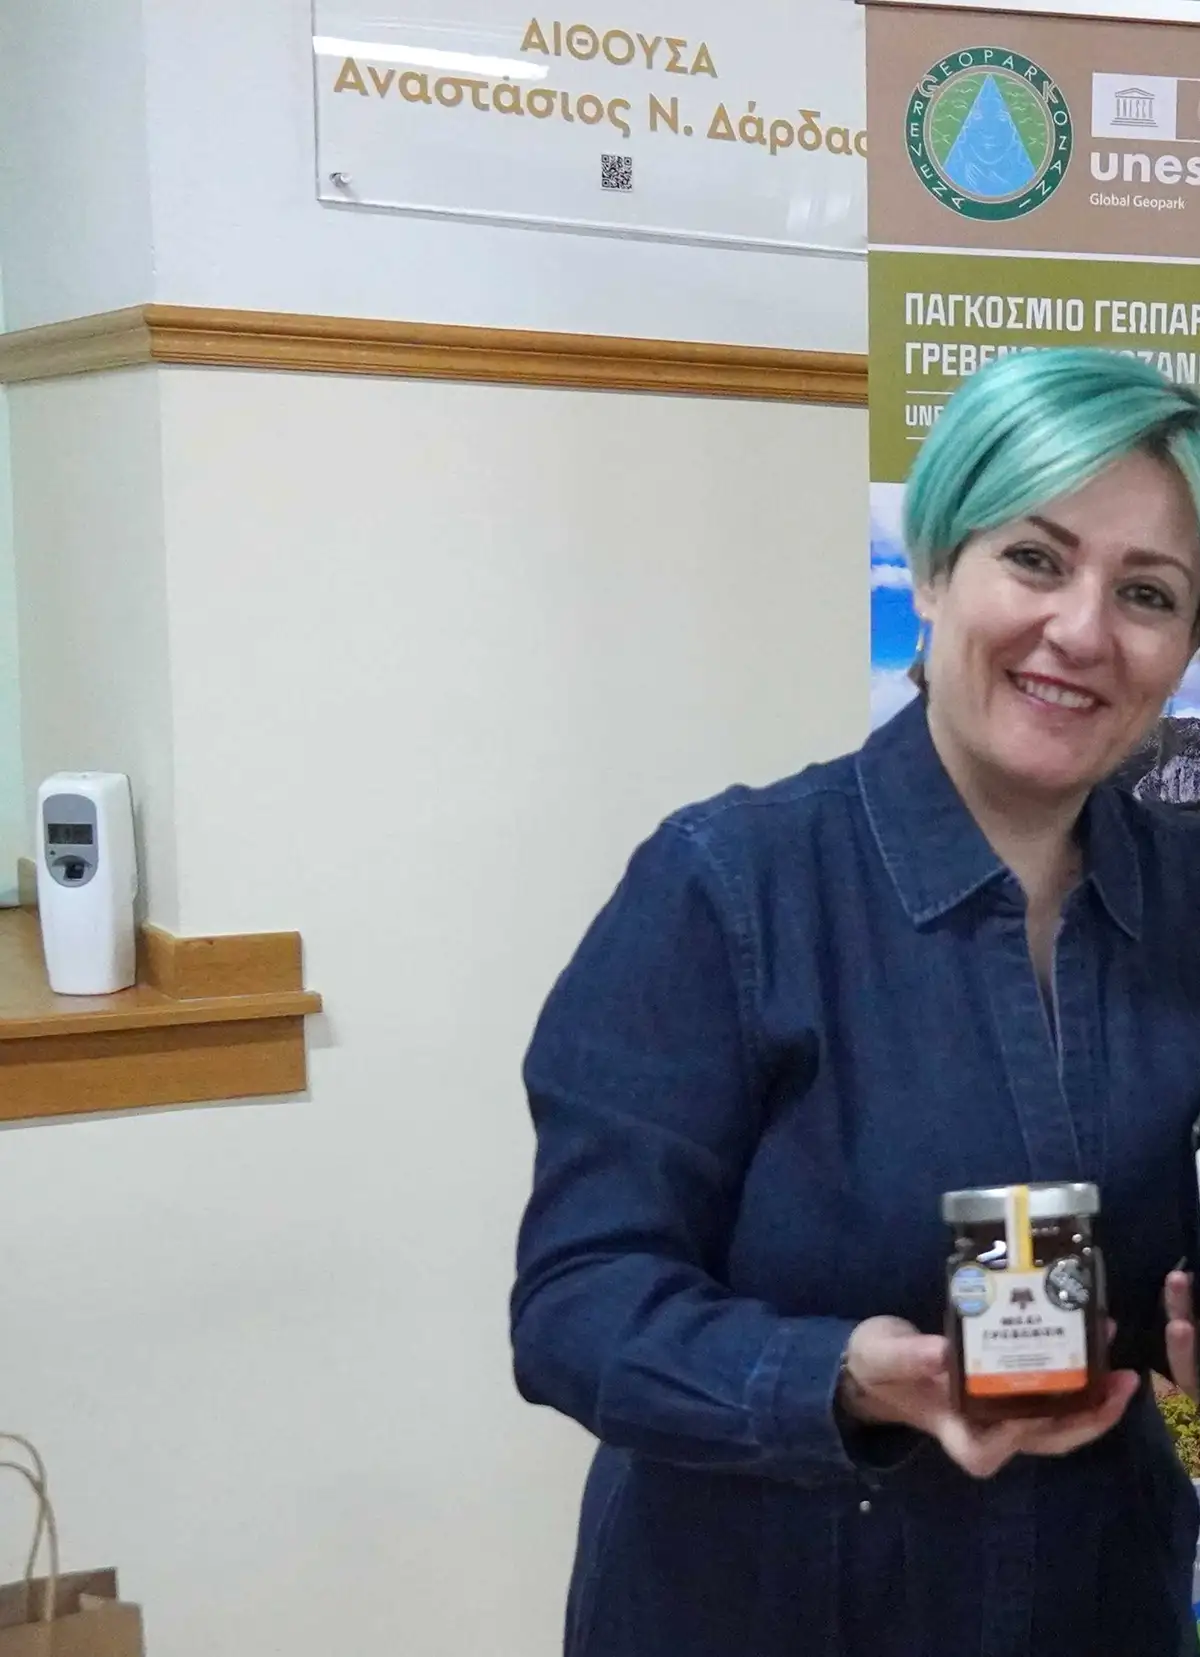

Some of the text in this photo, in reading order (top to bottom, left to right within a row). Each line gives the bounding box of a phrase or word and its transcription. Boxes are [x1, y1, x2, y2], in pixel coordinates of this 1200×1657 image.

[520, 18, 717, 78] ΑΙΘΟΥΣΑ
[333, 57, 631, 138] Αναστάσιος
[1089, 193, 1187, 211] Global Geopark
[905, 292, 1084, 332] ΠΑΓΚΟΣΜΙΟ
